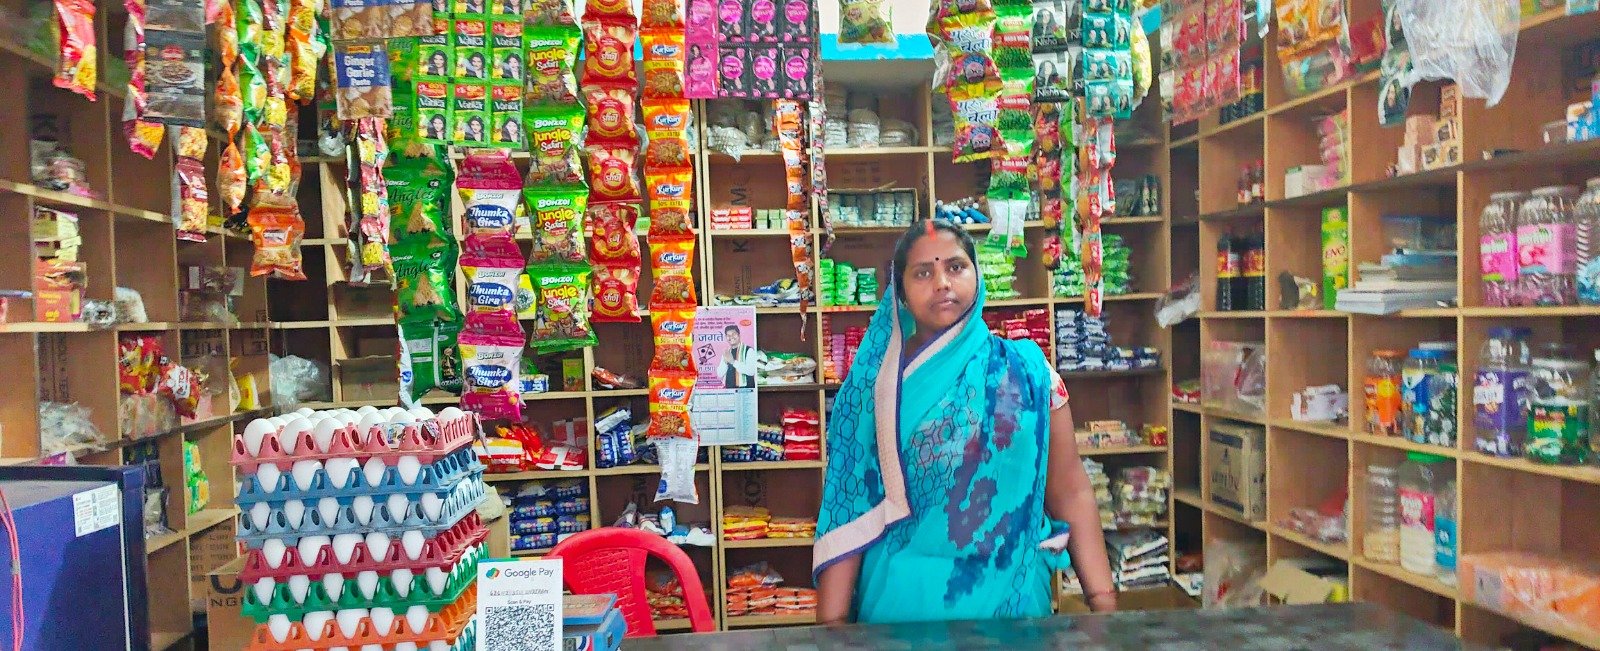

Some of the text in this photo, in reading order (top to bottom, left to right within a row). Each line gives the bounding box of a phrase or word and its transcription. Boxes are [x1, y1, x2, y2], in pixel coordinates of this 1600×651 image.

[1035, 37, 1057, 47] Nisha
[344, 56, 375, 69] Ginger
[528, 48, 567, 67] Jungle
[536, 59, 559, 71] Safari
[346, 67, 375, 78] Garlic
[350, 78, 371, 86] Paste
[1037, 88, 1061, 97] Nisha
[533, 128, 572, 147] Jungle
[540, 139, 563, 152] Safari
[468, 206, 509, 219] Thumka
[536, 207, 575, 228] Jungle
[544, 221, 567, 232] Safari
[470, 284, 510, 297] Thumka
[539, 286, 579, 304] Jungle
[547, 298, 571, 310] Safari
[470, 366, 509, 378] Thumka
[504, 567, 554, 579] Google Pay
